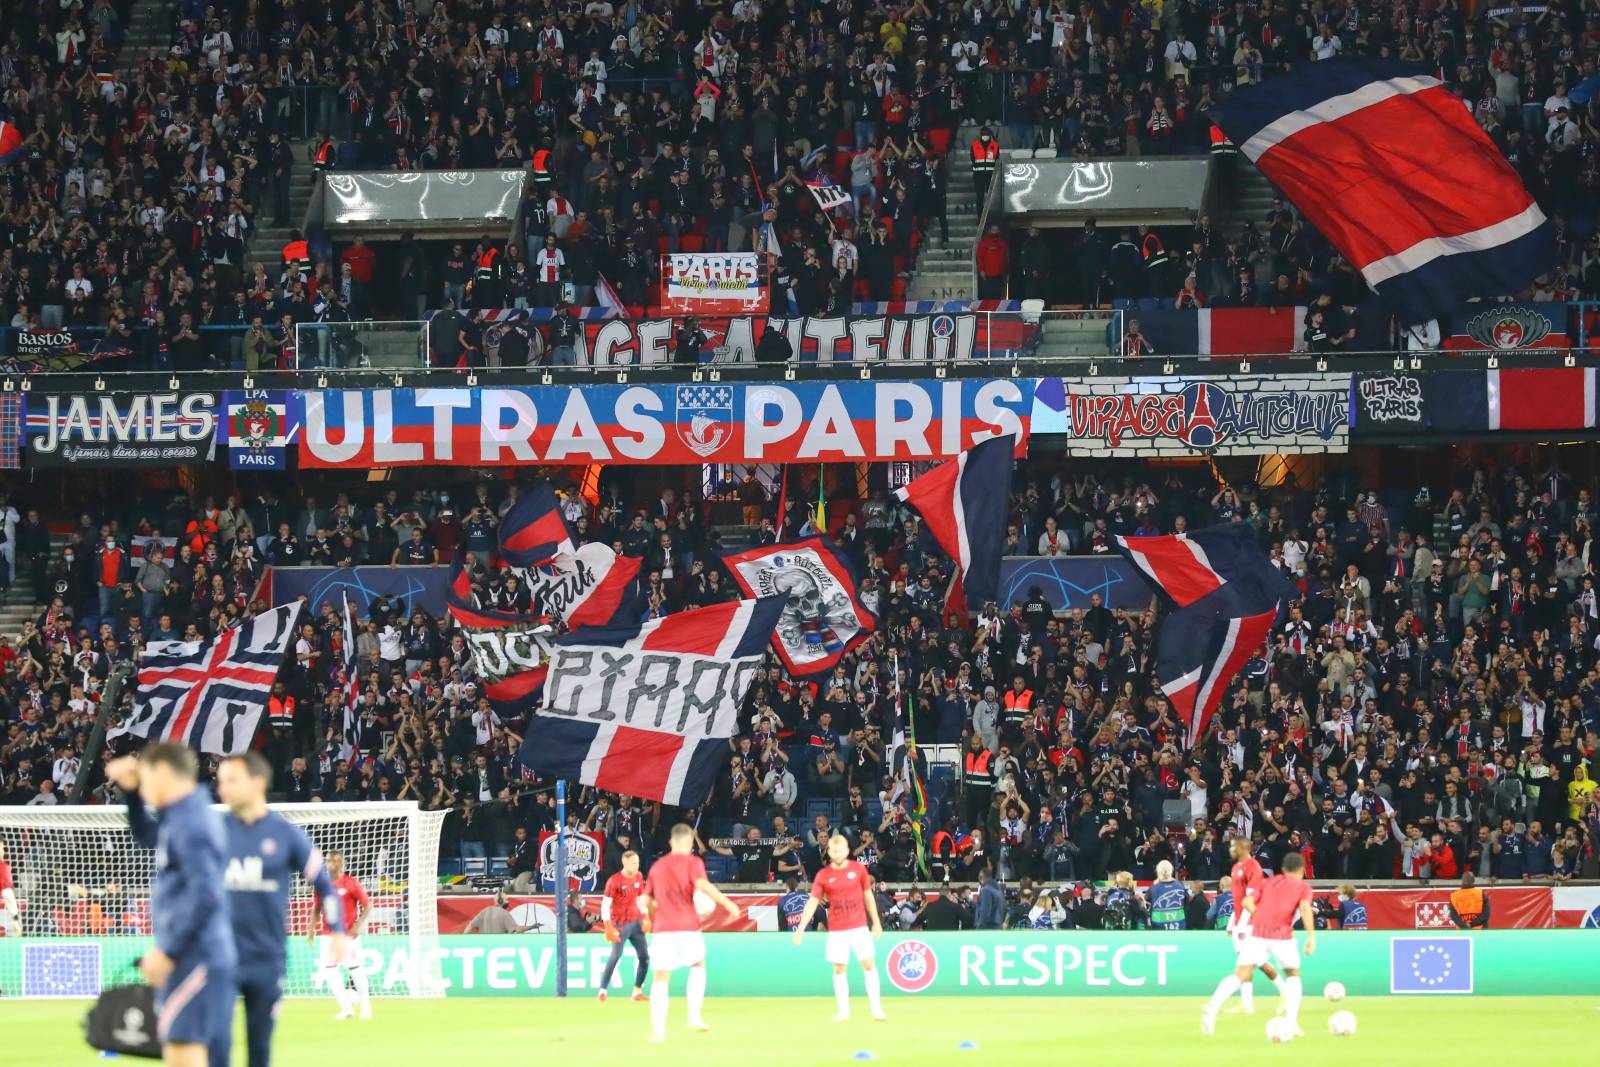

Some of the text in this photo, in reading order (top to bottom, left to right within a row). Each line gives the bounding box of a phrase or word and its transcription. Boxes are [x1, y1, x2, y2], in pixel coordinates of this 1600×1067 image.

[671, 255, 759, 283] PARIS
[245, 389, 269, 399] LPA
[1361, 377, 1422, 400] ULTRAS
[1370, 397, 1422, 420] PARIS
[34, 392, 215, 453] JAMES
[305, 379, 1023, 463] ULTRAS PARIS
[112, 443, 138, 458] dans
[140, 446, 160, 458] nos
[239, 454, 276, 466] PARIS
[959, 944, 1178, 987] RESPECT
